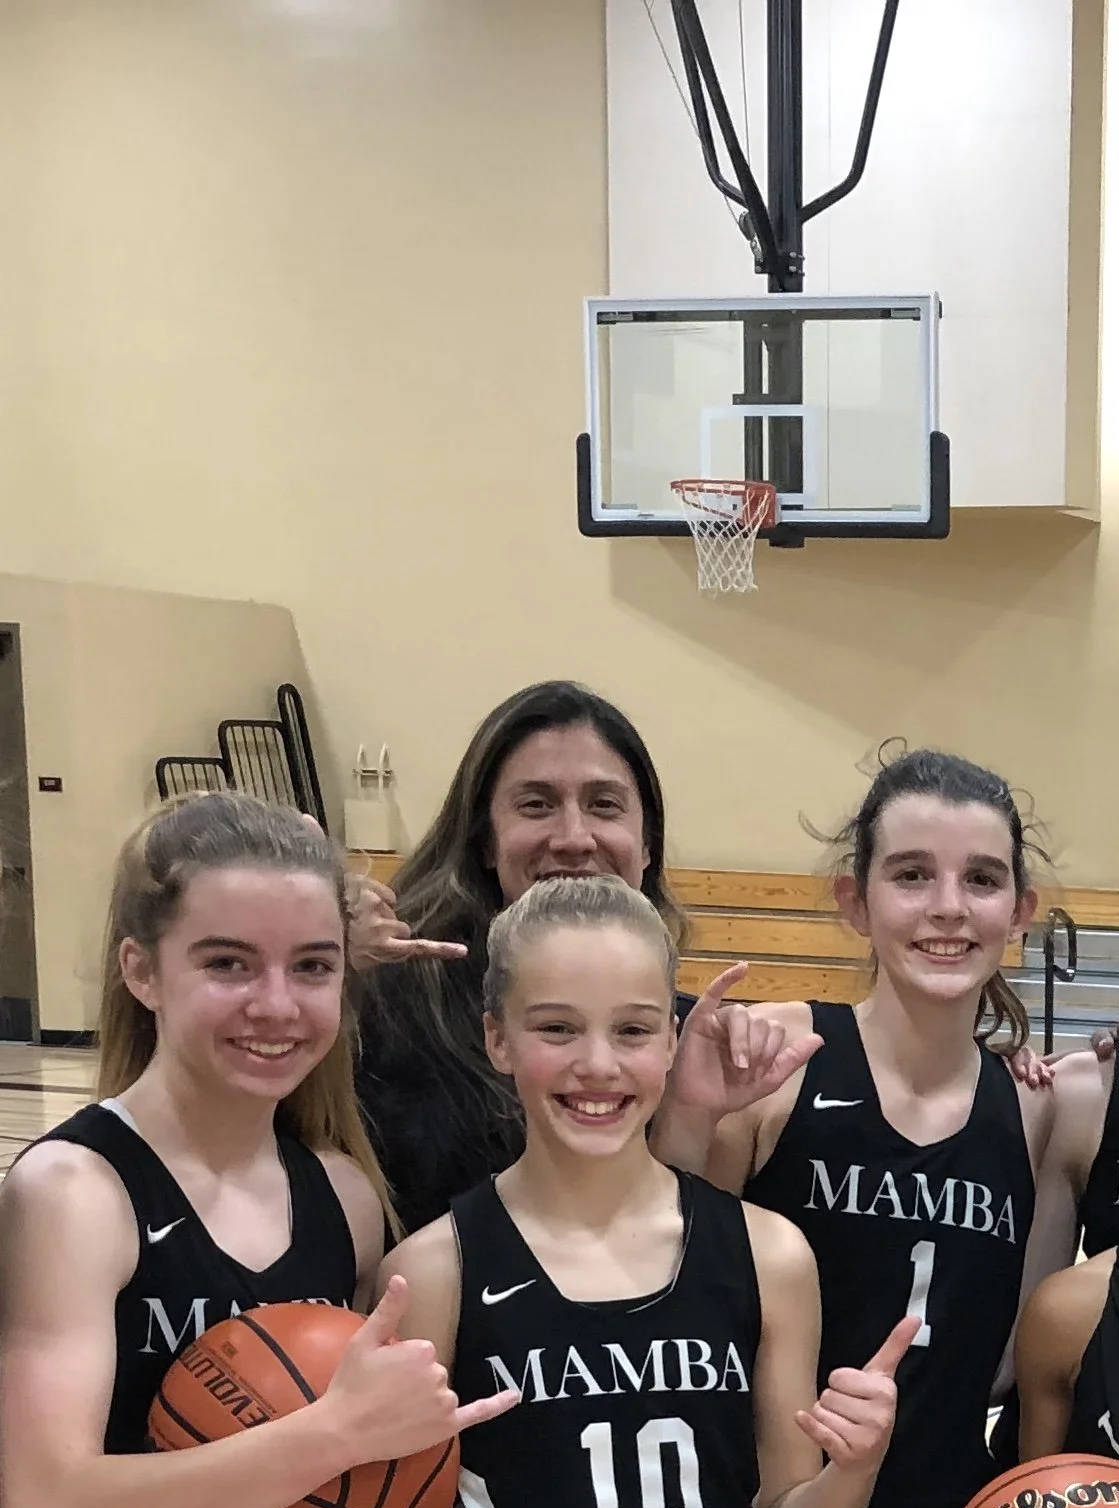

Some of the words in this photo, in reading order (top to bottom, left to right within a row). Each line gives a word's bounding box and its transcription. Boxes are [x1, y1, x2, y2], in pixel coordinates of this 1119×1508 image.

[803, 1158, 1017, 1245] MAMBA
[906, 1239, 936, 1347] 1
[484, 1337, 750, 1403] MAMBA
